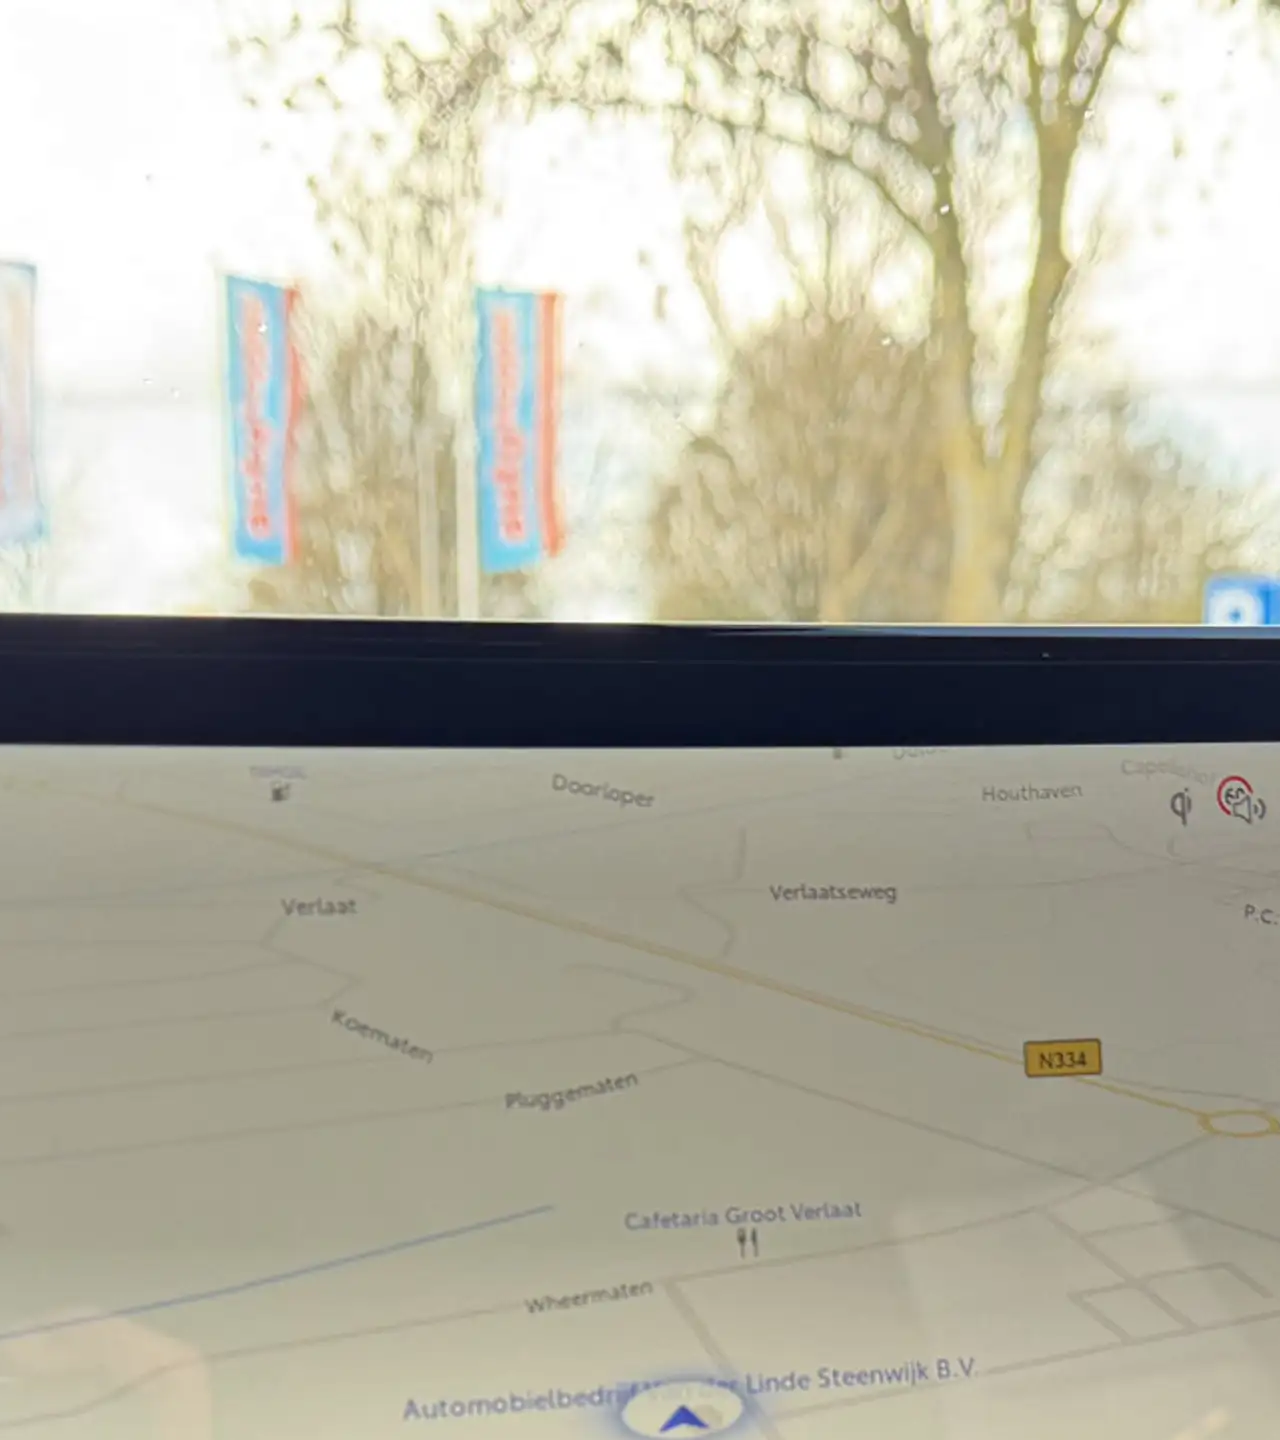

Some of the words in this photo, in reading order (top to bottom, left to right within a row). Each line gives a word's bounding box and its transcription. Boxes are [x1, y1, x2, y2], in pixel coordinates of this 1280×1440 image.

[552, 773, 655, 809] Doorloper
[982, 783, 1083, 803] Houthaven
[281, 896, 357, 918] Verlaat
[769, 884, 898, 905] Verlaatseweg
[1243, 903, 1278, 926] P.C.
[329, 1009, 435, 1065] Koematen
[1038, 1050, 1087, 1069] N334
[504, 1071, 638, 1113] Pluggematen
[624, 1208, 720, 1232] Cafetaria
[725, 1204, 786, 1226] Groot
[790, 1201, 862, 1221] Verlaat
[525, 1280, 653, 1315] Wheermaten
[746, 1372, 811, 1396] Linde
[816, 1360, 929, 1391] Steenwijk
[936, 1357, 979, 1381] B.V.
